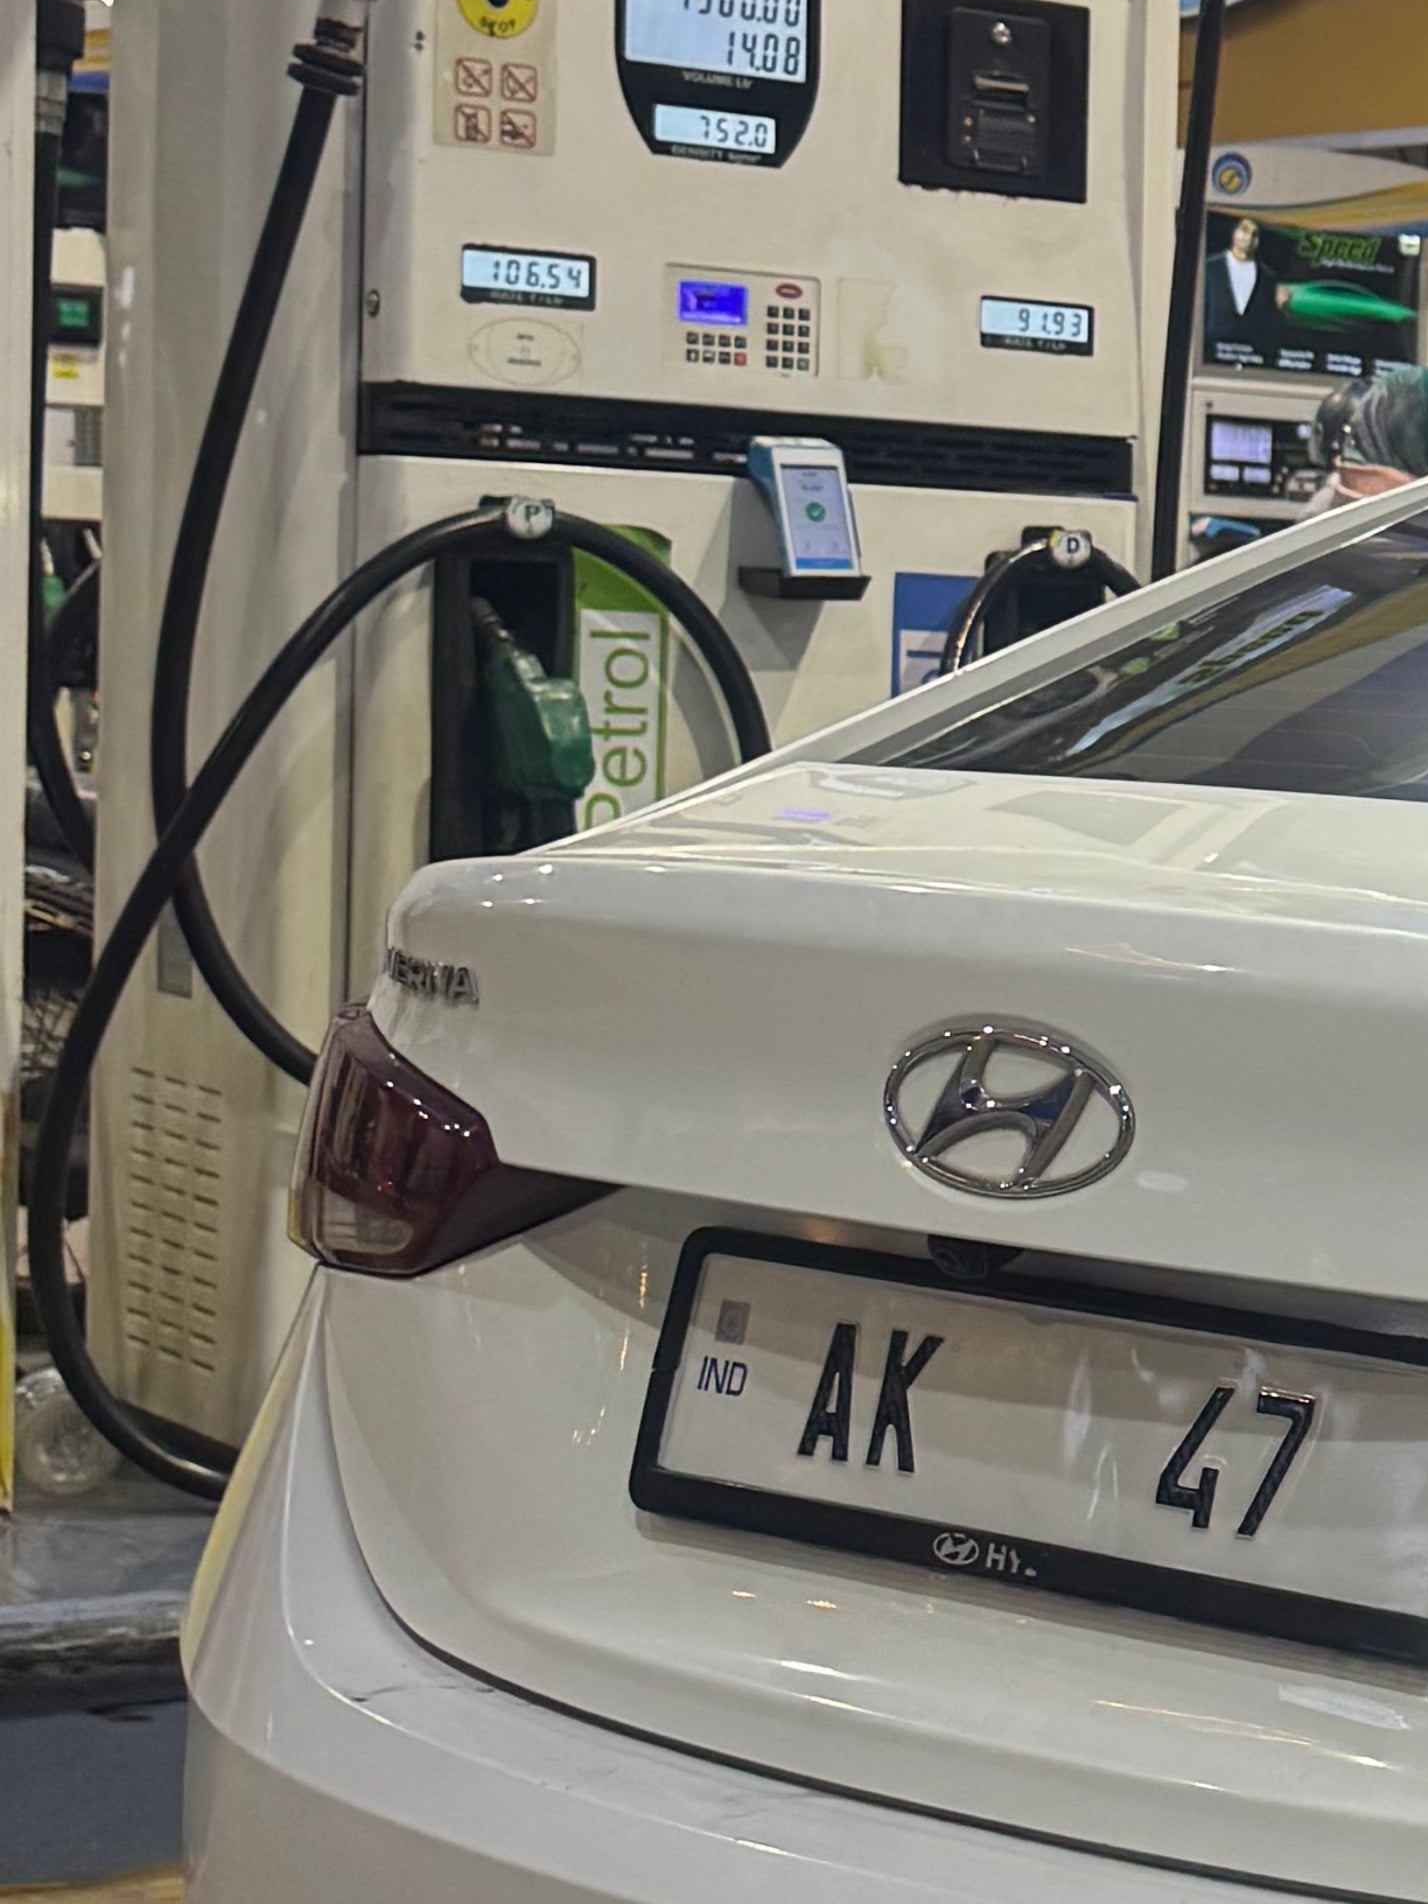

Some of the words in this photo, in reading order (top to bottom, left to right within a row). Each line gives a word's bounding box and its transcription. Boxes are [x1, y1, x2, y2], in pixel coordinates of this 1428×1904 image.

[726, 30, 801, 77] 14.08
[699, 114, 769, 149] 752.0
[492, 259, 582, 290] 106.54
[1018, 307, 1083, 338] 91.93
[523, 504, 541, 523] P
[1066, 537, 1081, 554] D
[696, 1355, 749, 1397] IND
[796, 1322, 945, 1474] AK
[1155, 1383, 1319, 1537] 47
